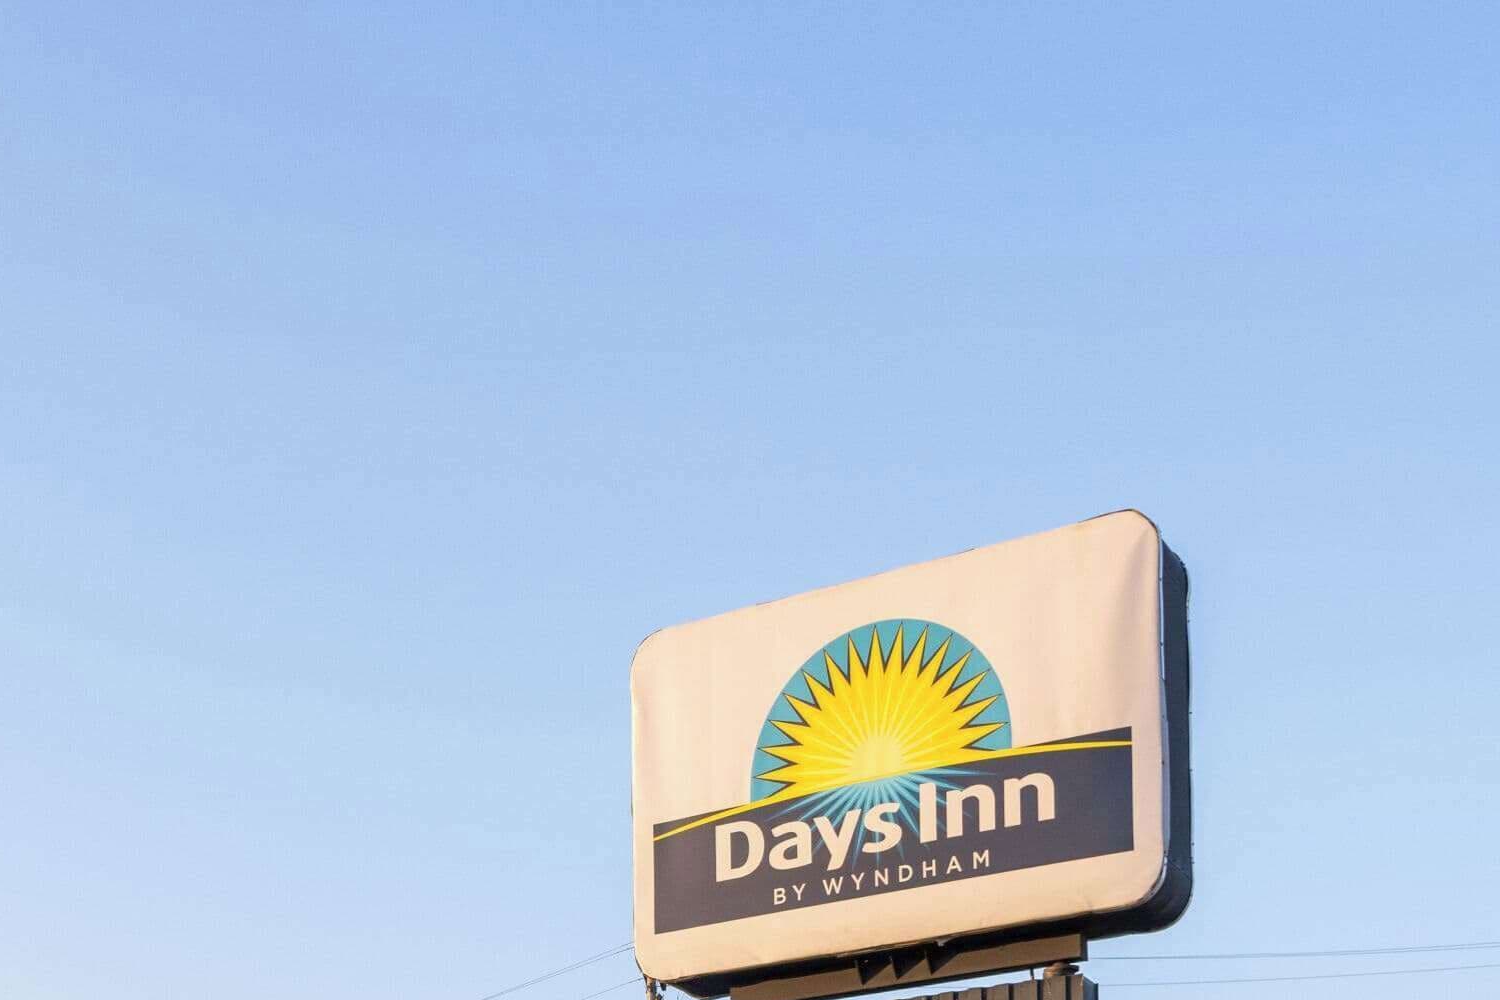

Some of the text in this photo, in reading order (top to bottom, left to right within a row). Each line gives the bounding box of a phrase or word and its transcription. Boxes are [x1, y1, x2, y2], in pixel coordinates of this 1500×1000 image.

[714, 771, 1056, 883] Days Inn
[773, 849, 991, 906] BY WYNDHAM
